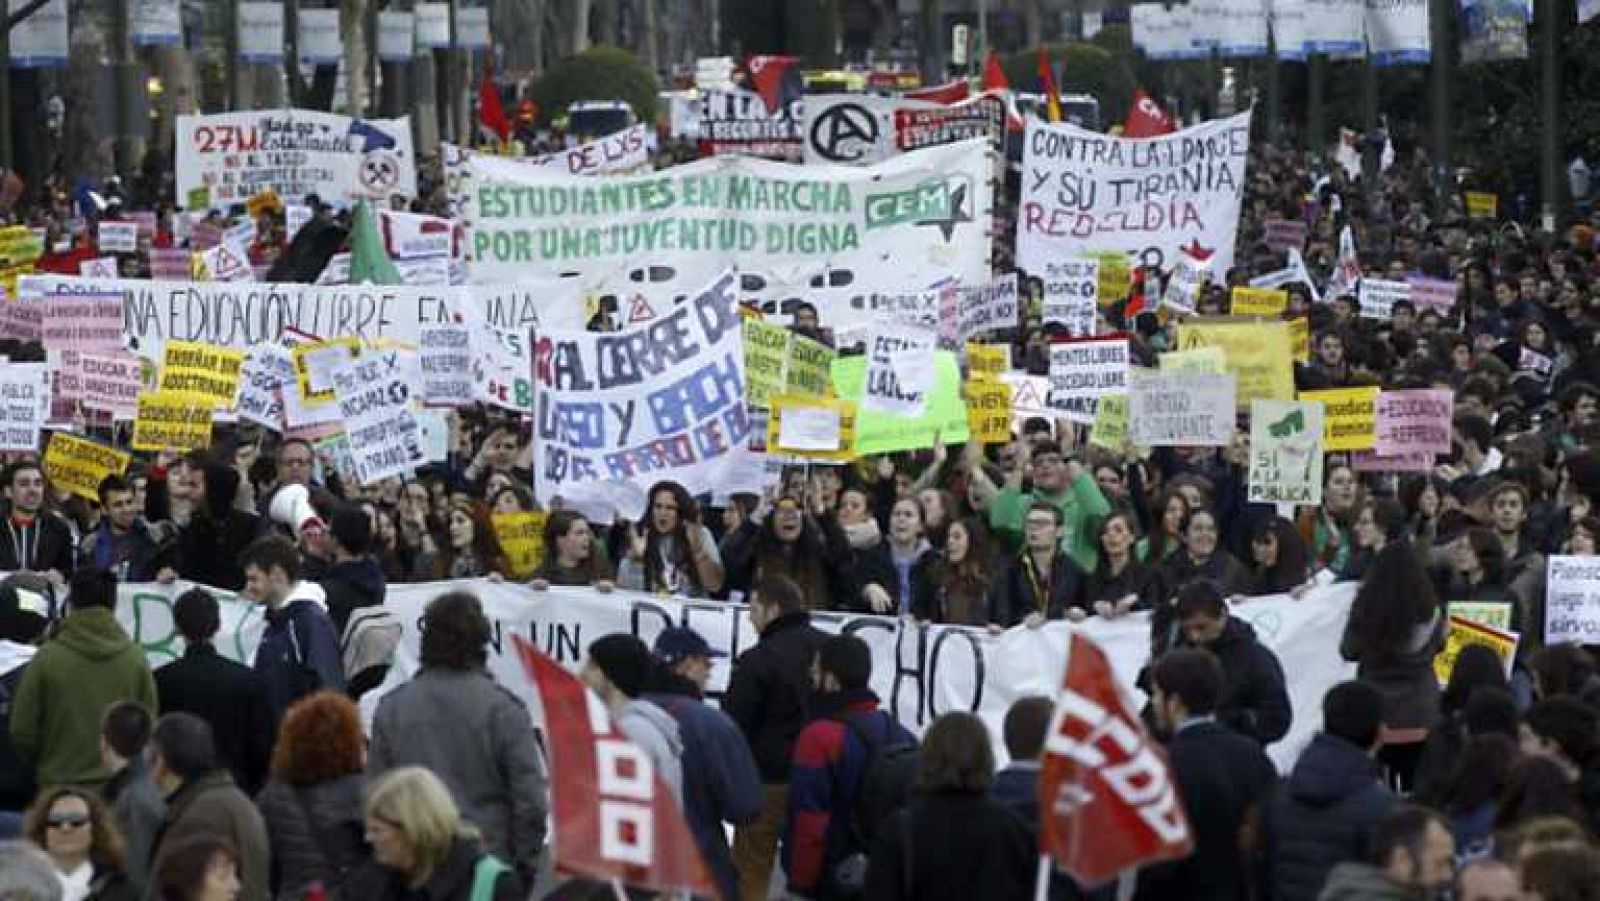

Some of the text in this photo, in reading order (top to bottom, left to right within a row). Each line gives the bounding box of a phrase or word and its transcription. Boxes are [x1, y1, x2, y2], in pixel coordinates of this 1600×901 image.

[568, 146, 598, 174] DE
[1032, 129, 1123, 167] CONTRA
[1133, 141, 1161, 168] LA
[478, 178, 676, 221] ESTUDIANTES
[683, 178, 721, 207] EN
[728, 178, 852, 213] MARCHA
[1031, 167, 1050, 191] Y
[867, 183, 952, 222] CEM
[473, 229, 532, 262] POR
[540, 227, 601, 260] UNA
[602, 219, 757, 257] JUVENTUD
[765, 221, 860, 254] DIGNA
[556, 340, 594, 391] AL
[694, 271, 741, 345] DE
[610, 400, 634, 447] Y
[532, 620, 581, 662] UN
